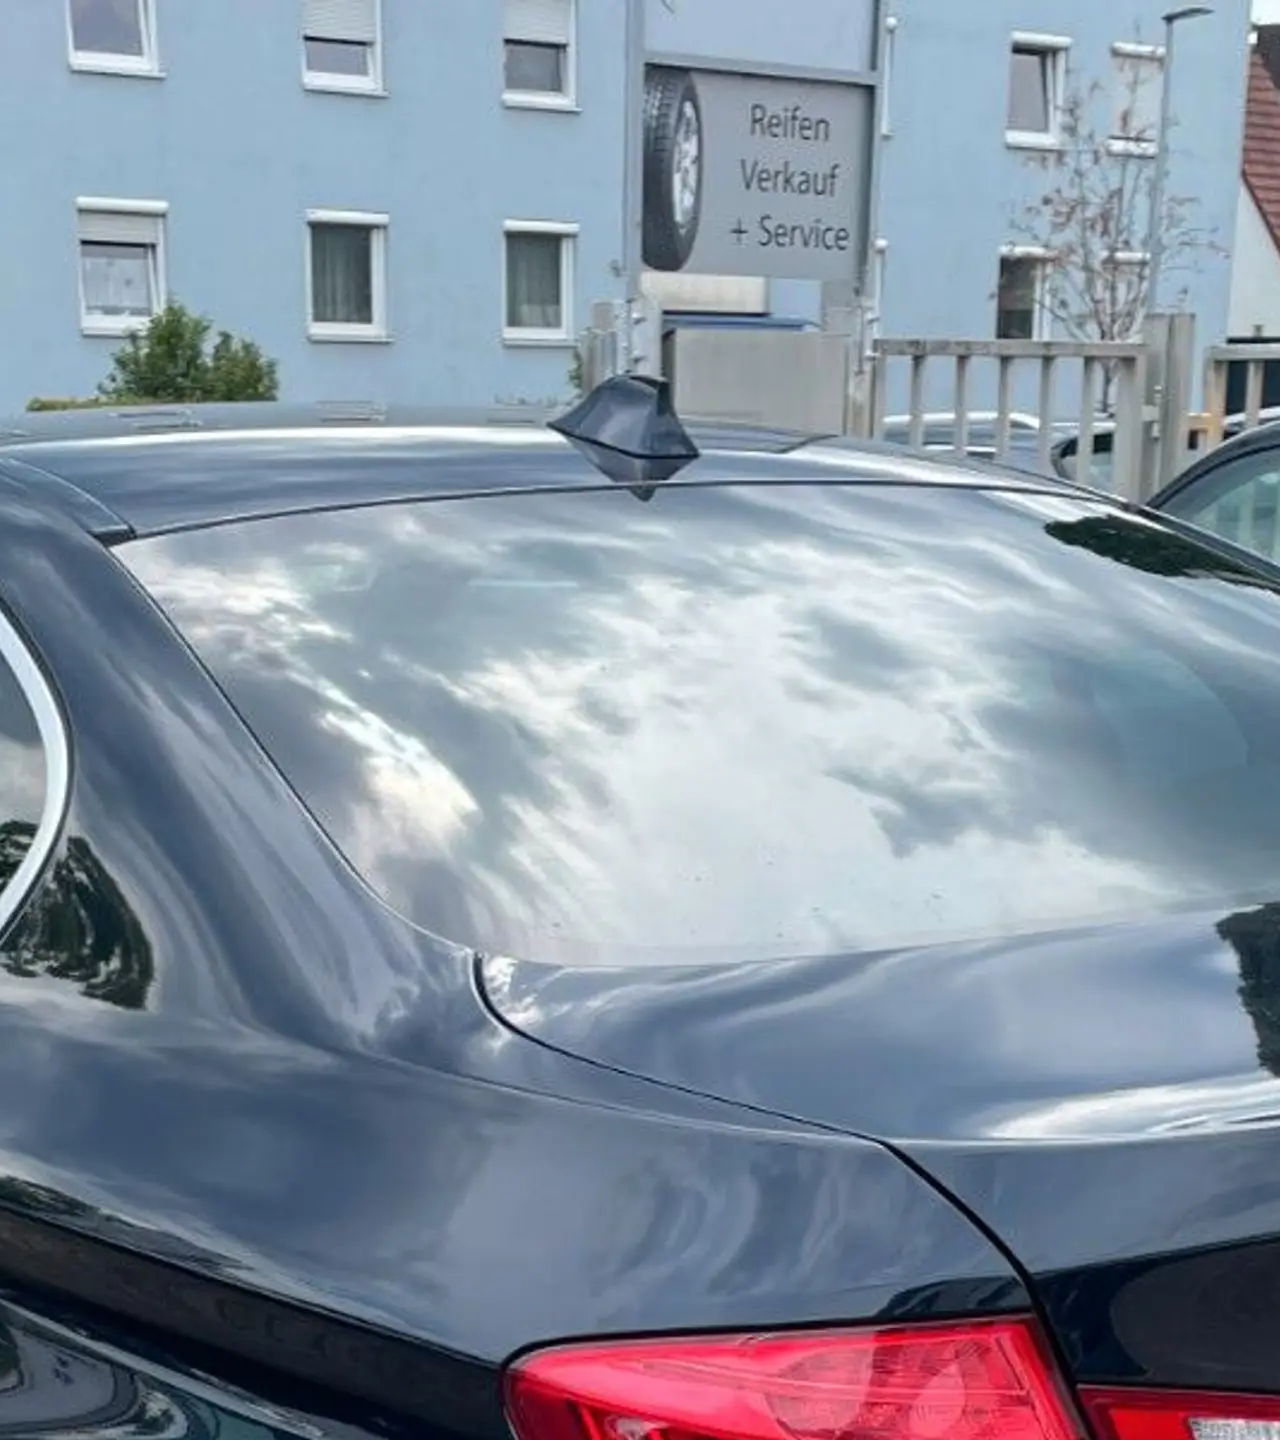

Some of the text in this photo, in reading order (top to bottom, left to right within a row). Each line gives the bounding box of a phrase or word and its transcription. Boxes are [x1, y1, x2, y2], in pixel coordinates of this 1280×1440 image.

[750, 103, 830, 142] Reifen
[740, 159, 840, 197] Verkauf
[729, 214, 850, 251] + Service
